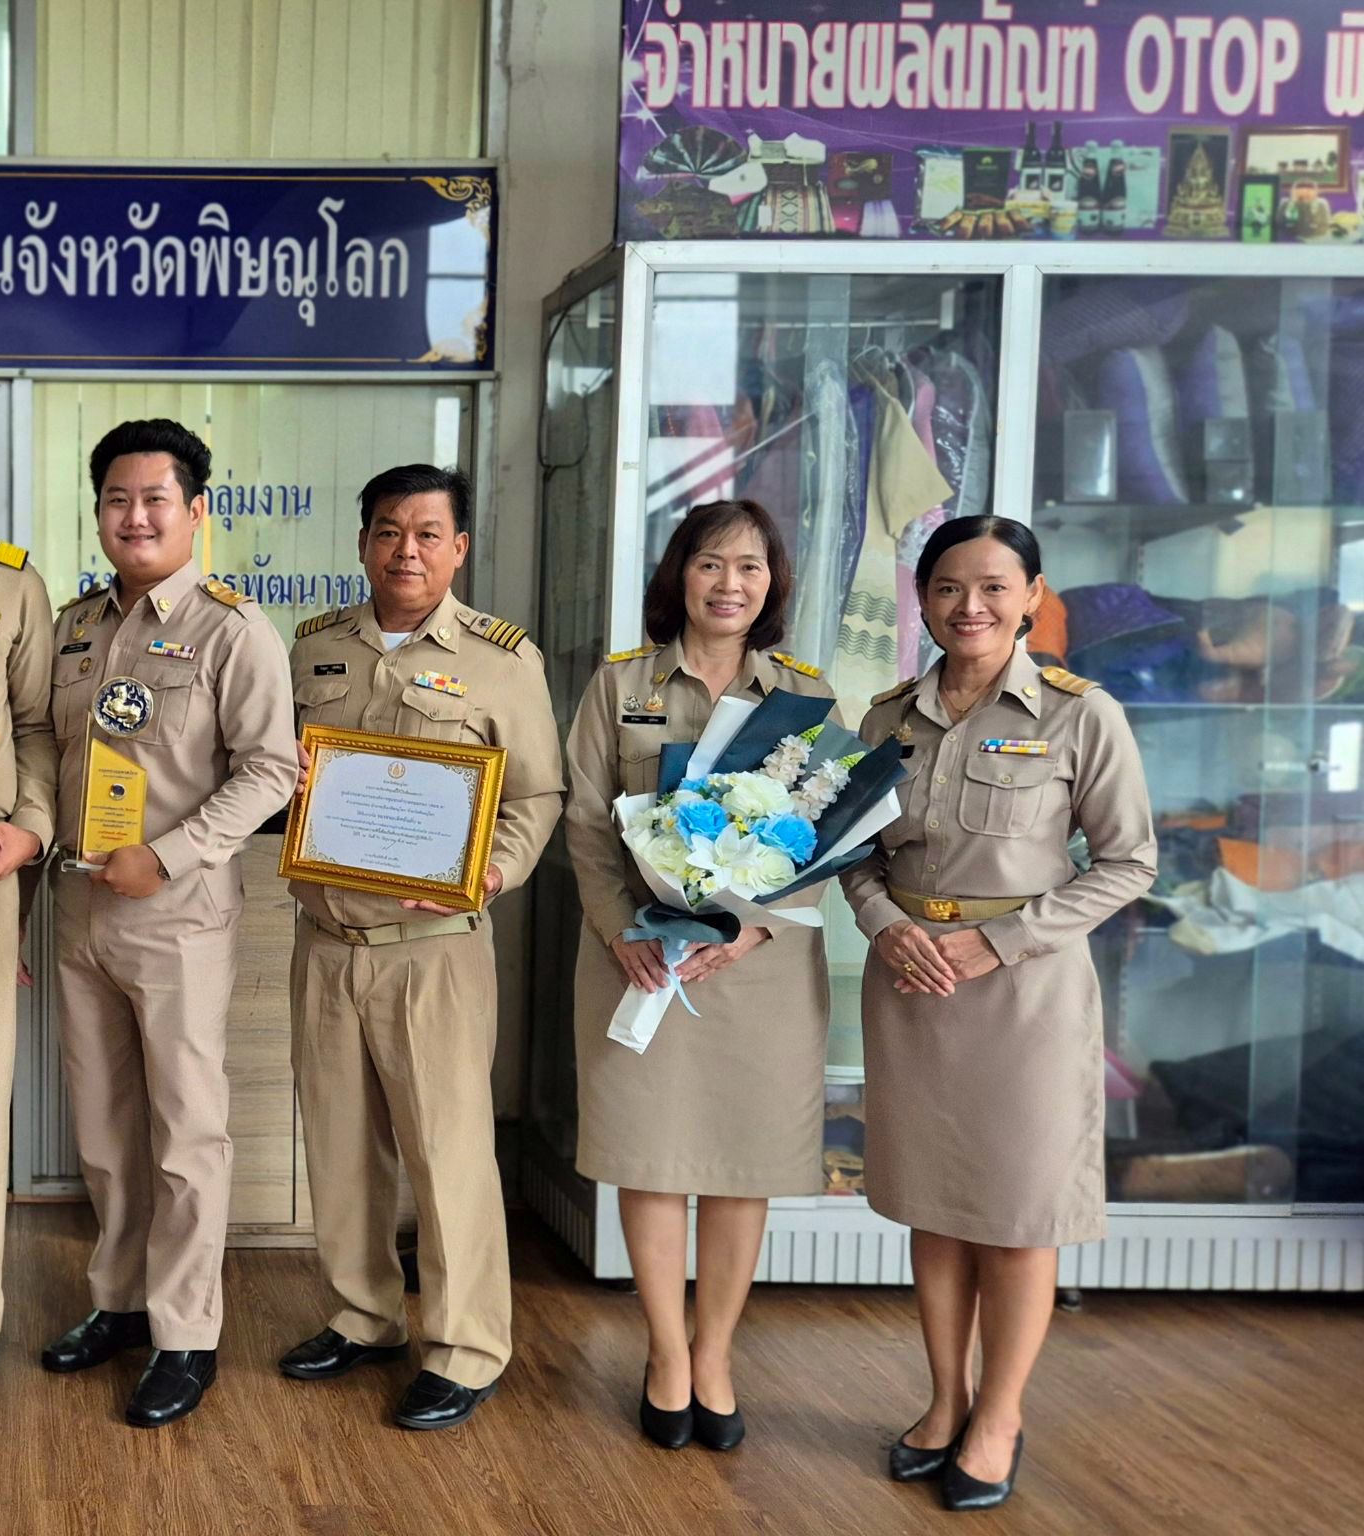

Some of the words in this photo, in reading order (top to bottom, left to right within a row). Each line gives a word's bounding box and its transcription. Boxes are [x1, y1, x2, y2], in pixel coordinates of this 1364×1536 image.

[644, 0, 1098, 112] จำหนายผลิตภัณฑ
[1124, 14, 1301, 117] OTOP
